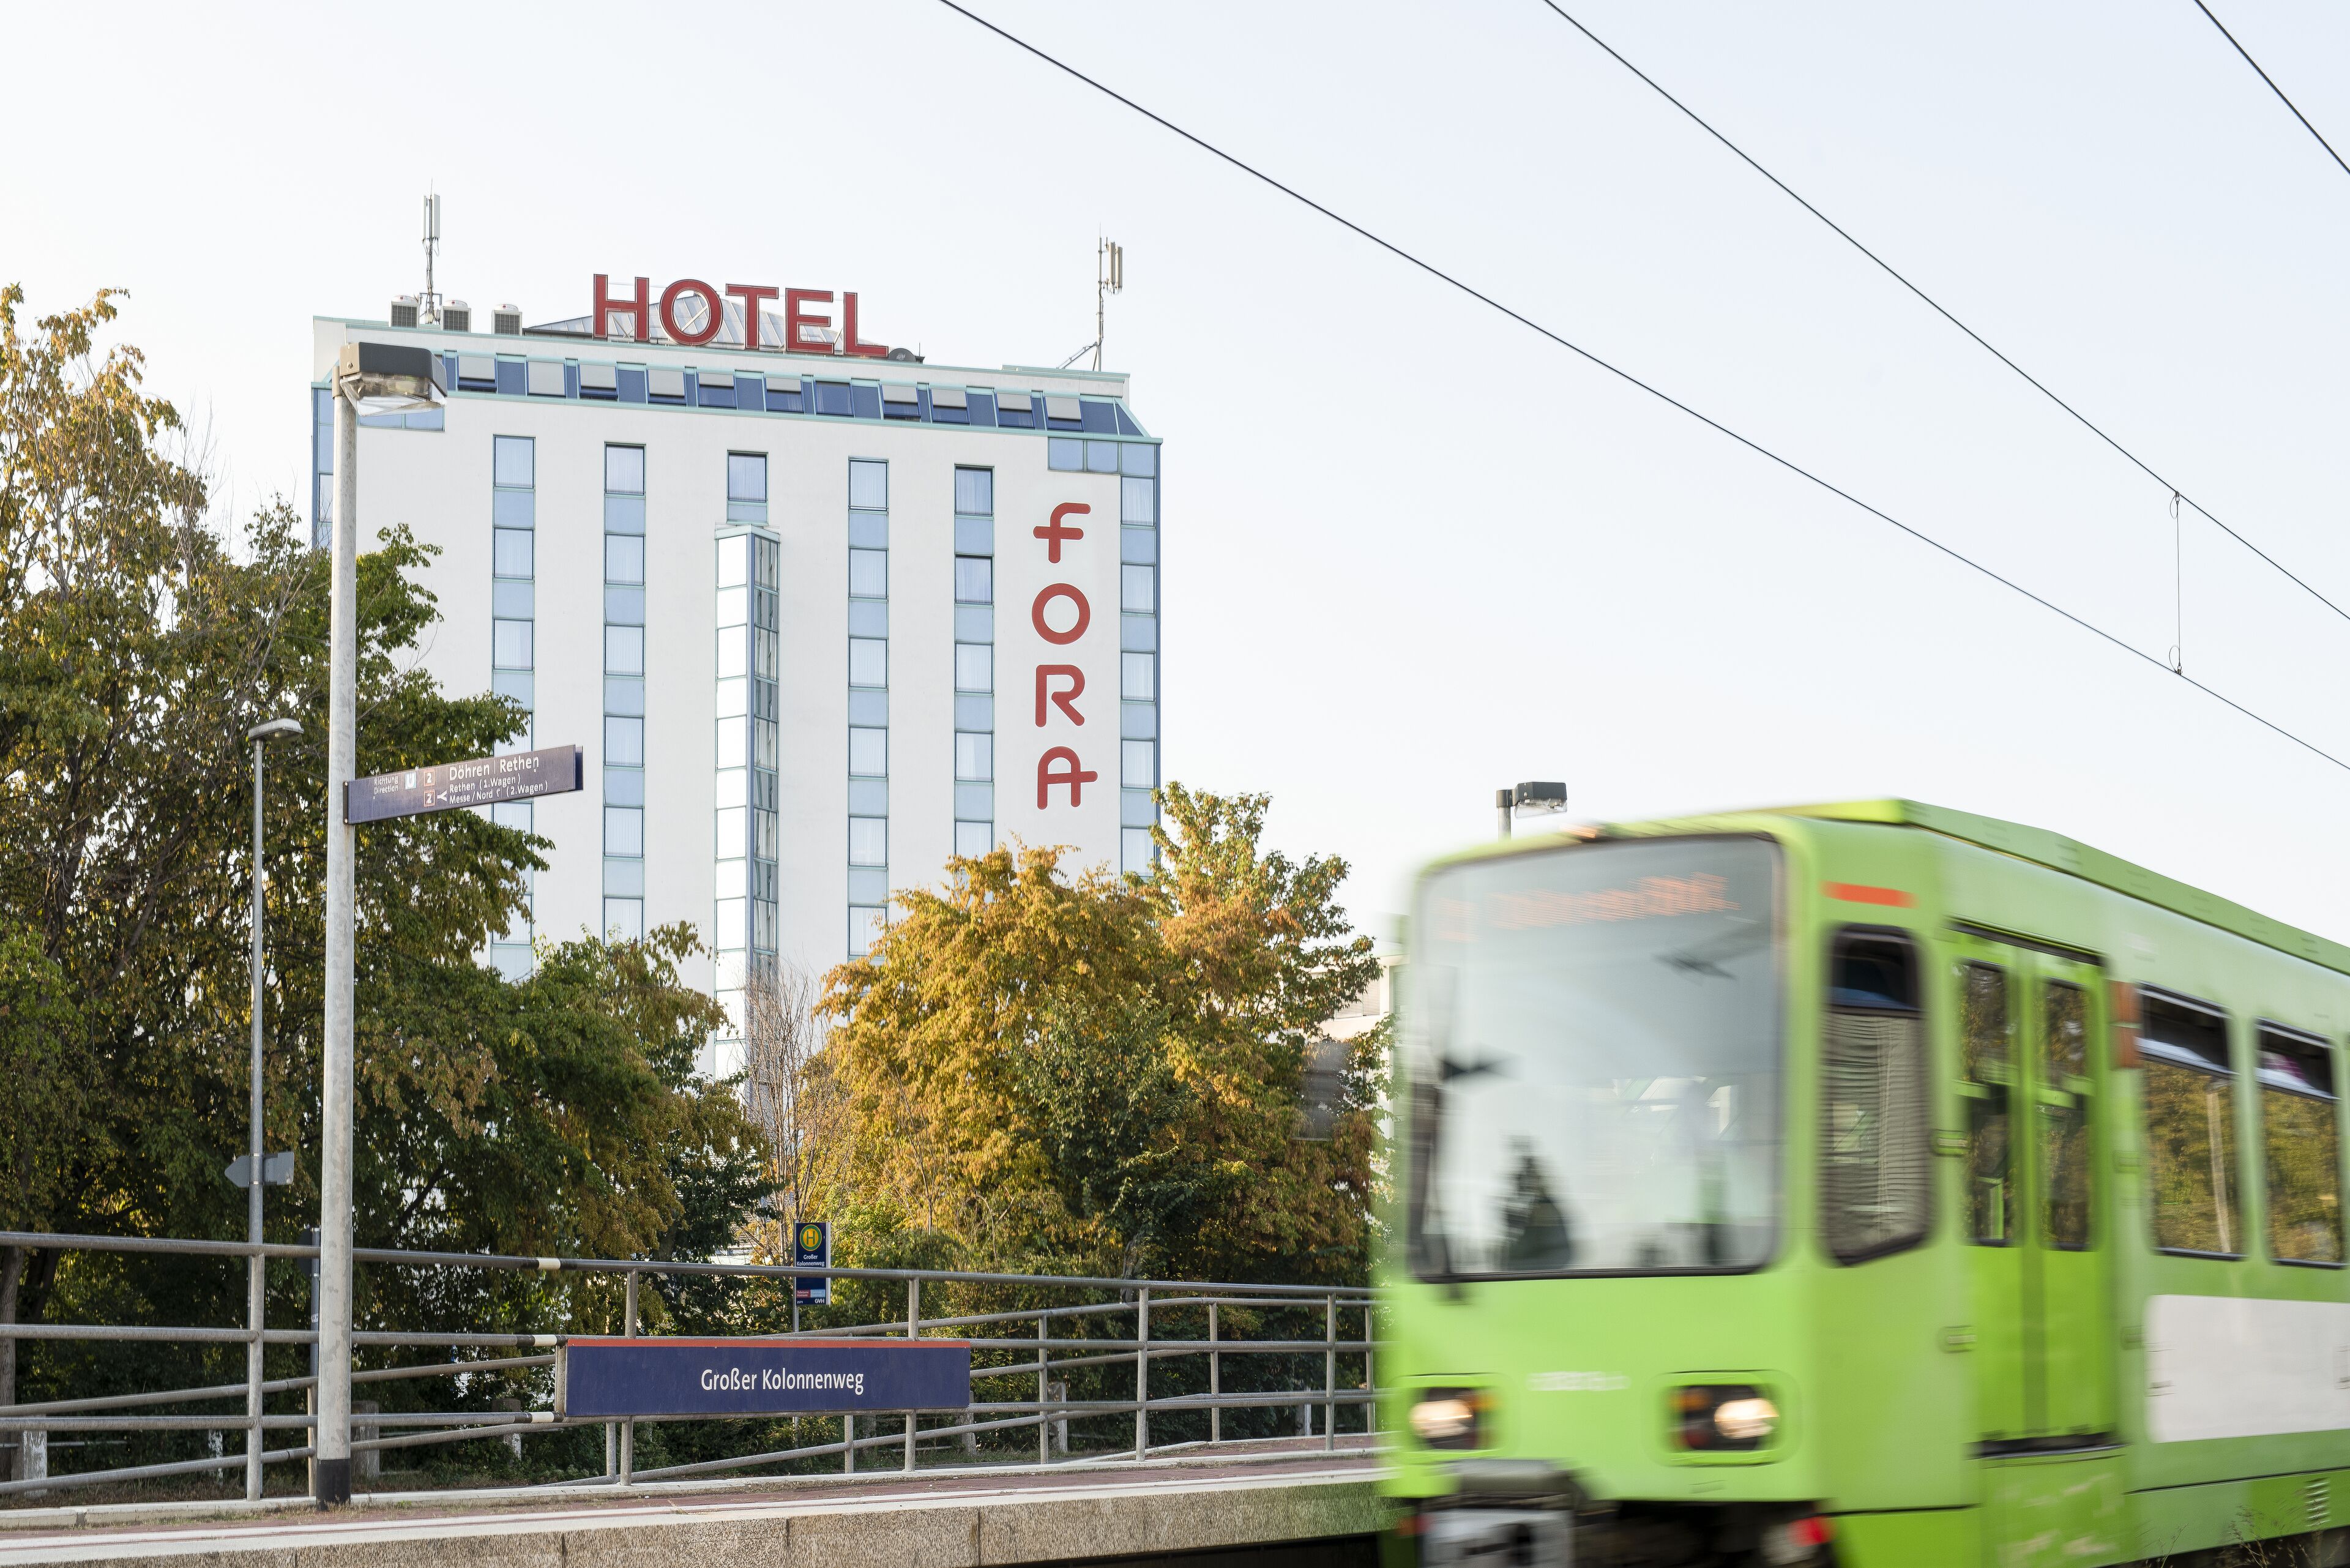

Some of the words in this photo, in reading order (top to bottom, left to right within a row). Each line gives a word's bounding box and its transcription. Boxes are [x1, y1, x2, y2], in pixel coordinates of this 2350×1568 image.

[592, 274, 889, 357] HOTEL
[449, 763, 490, 781] Döhren
[500, 755, 539, 773] Rethen
[374, 775, 398, 786] Richtung
[374, 784, 398, 795] Direction
[449, 782, 476, 794] Rethen
[701, 1367, 757, 1391] Großer
[763, 1367, 864, 1395] Kolonnenweg
